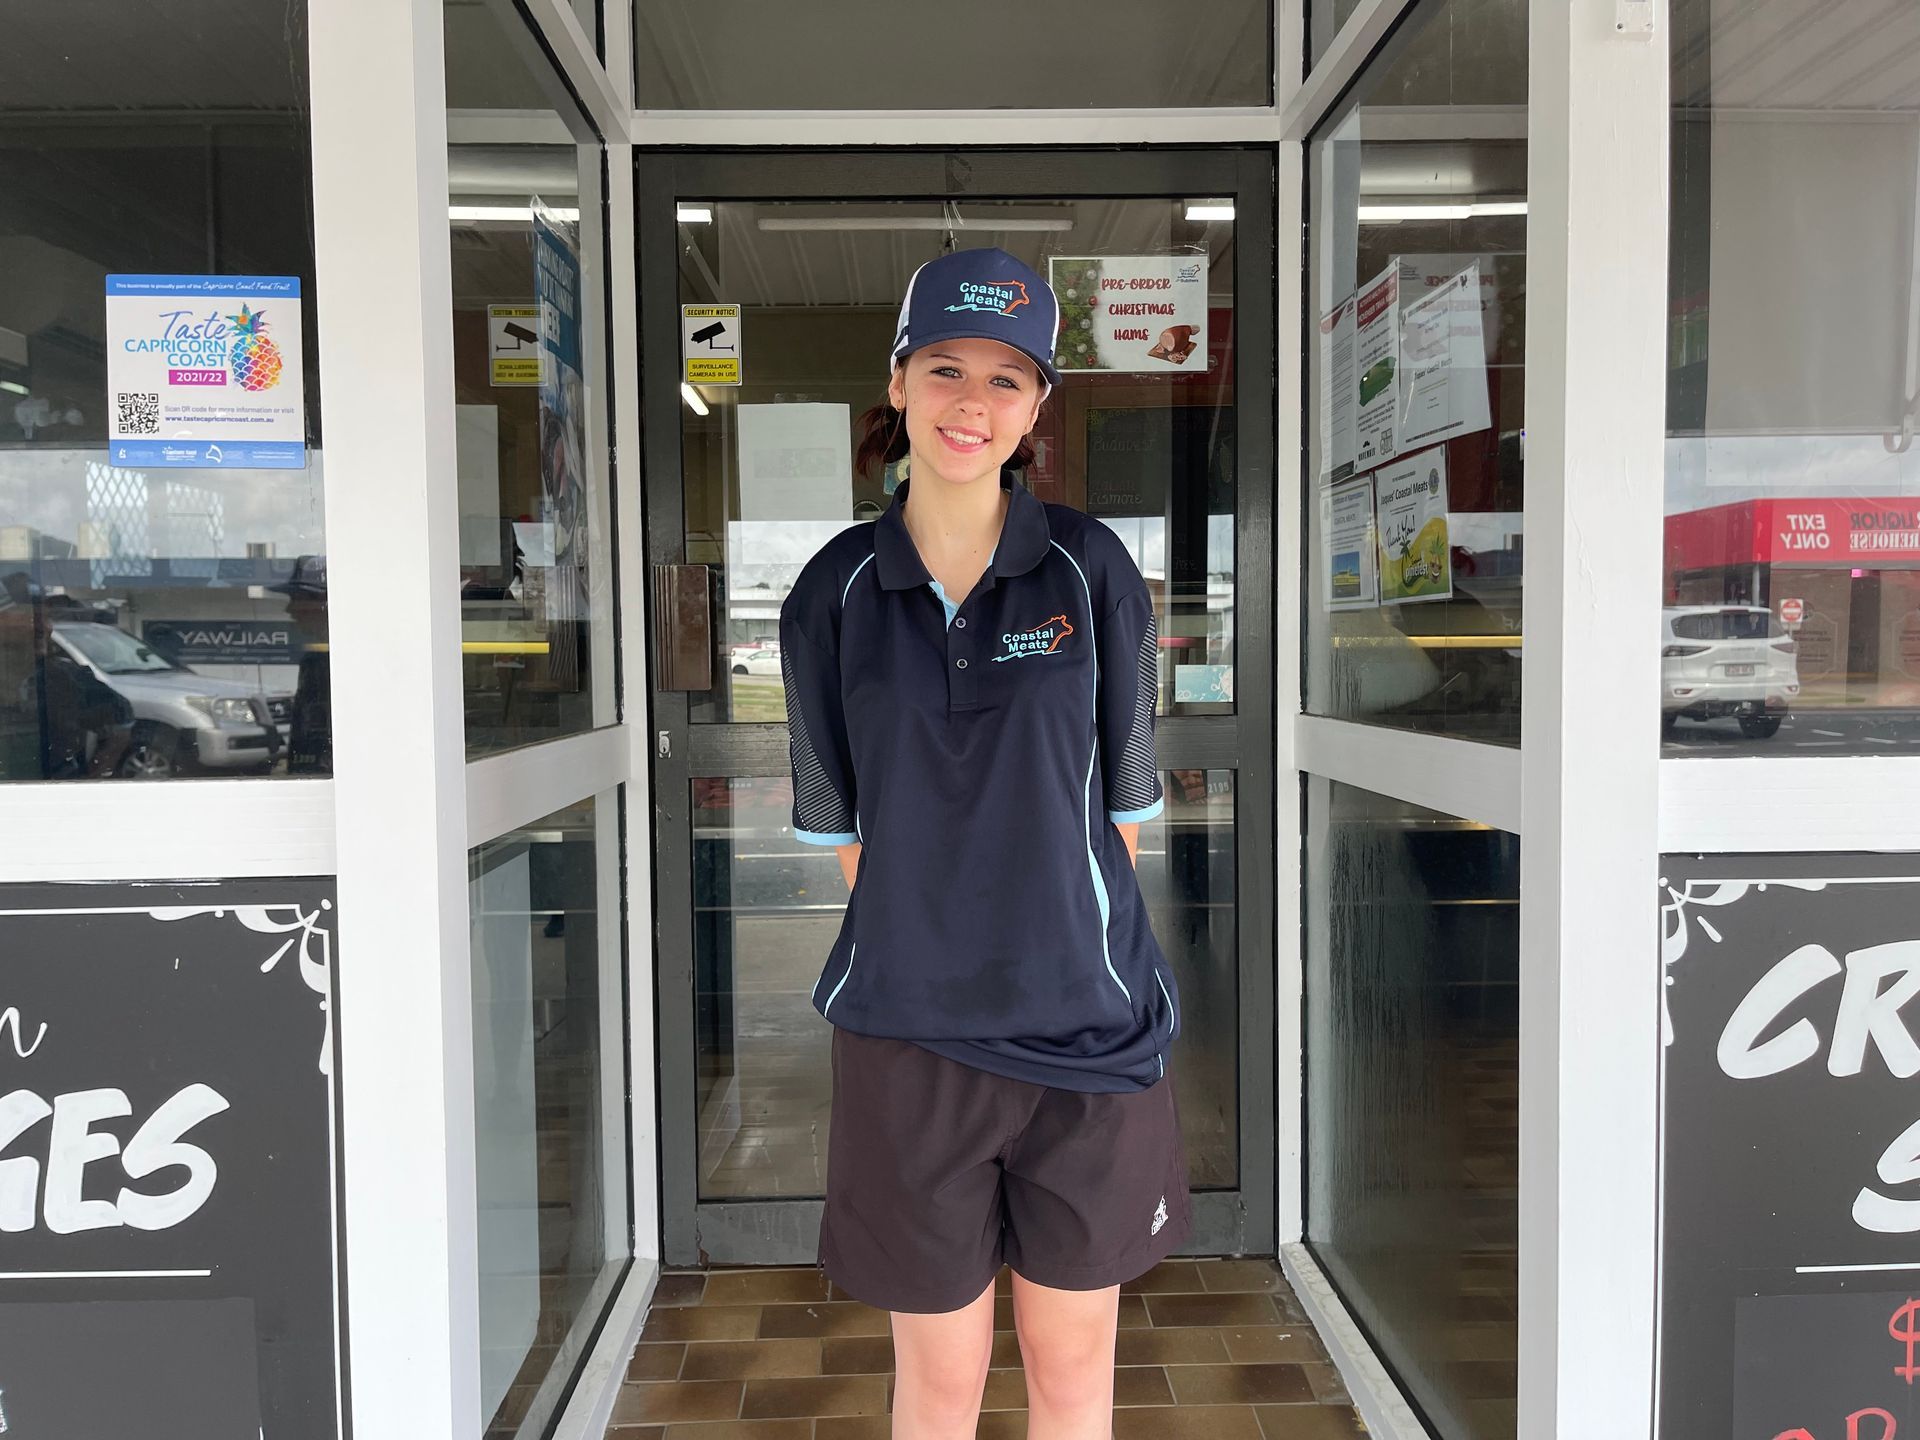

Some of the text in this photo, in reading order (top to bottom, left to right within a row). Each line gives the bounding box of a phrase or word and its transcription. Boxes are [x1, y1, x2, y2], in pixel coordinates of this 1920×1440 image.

[960, 282, 1013, 300] Coastal
[1101, 278, 1172, 291] PRE-ORDER
[963, 293, 1006, 309] Meats
[1108, 303, 1176, 316] CHRISTMAS
[158, 311, 231, 340] Taste
[124, 339, 227, 353] CAPRICORN
[167, 353, 227, 367] COAST
[176, 372, 223, 383] 2021/22
[164, 405, 180, 413] Scan
[236, 406, 273, 414] information
[165, 416, 275, 424] www.tastecapricorncoast.com.au
[1412, 481, 1429, 494] Meats
[1002, 628, 1054, 644] Coastal
[1008, 640, 1049, 653] Meats
